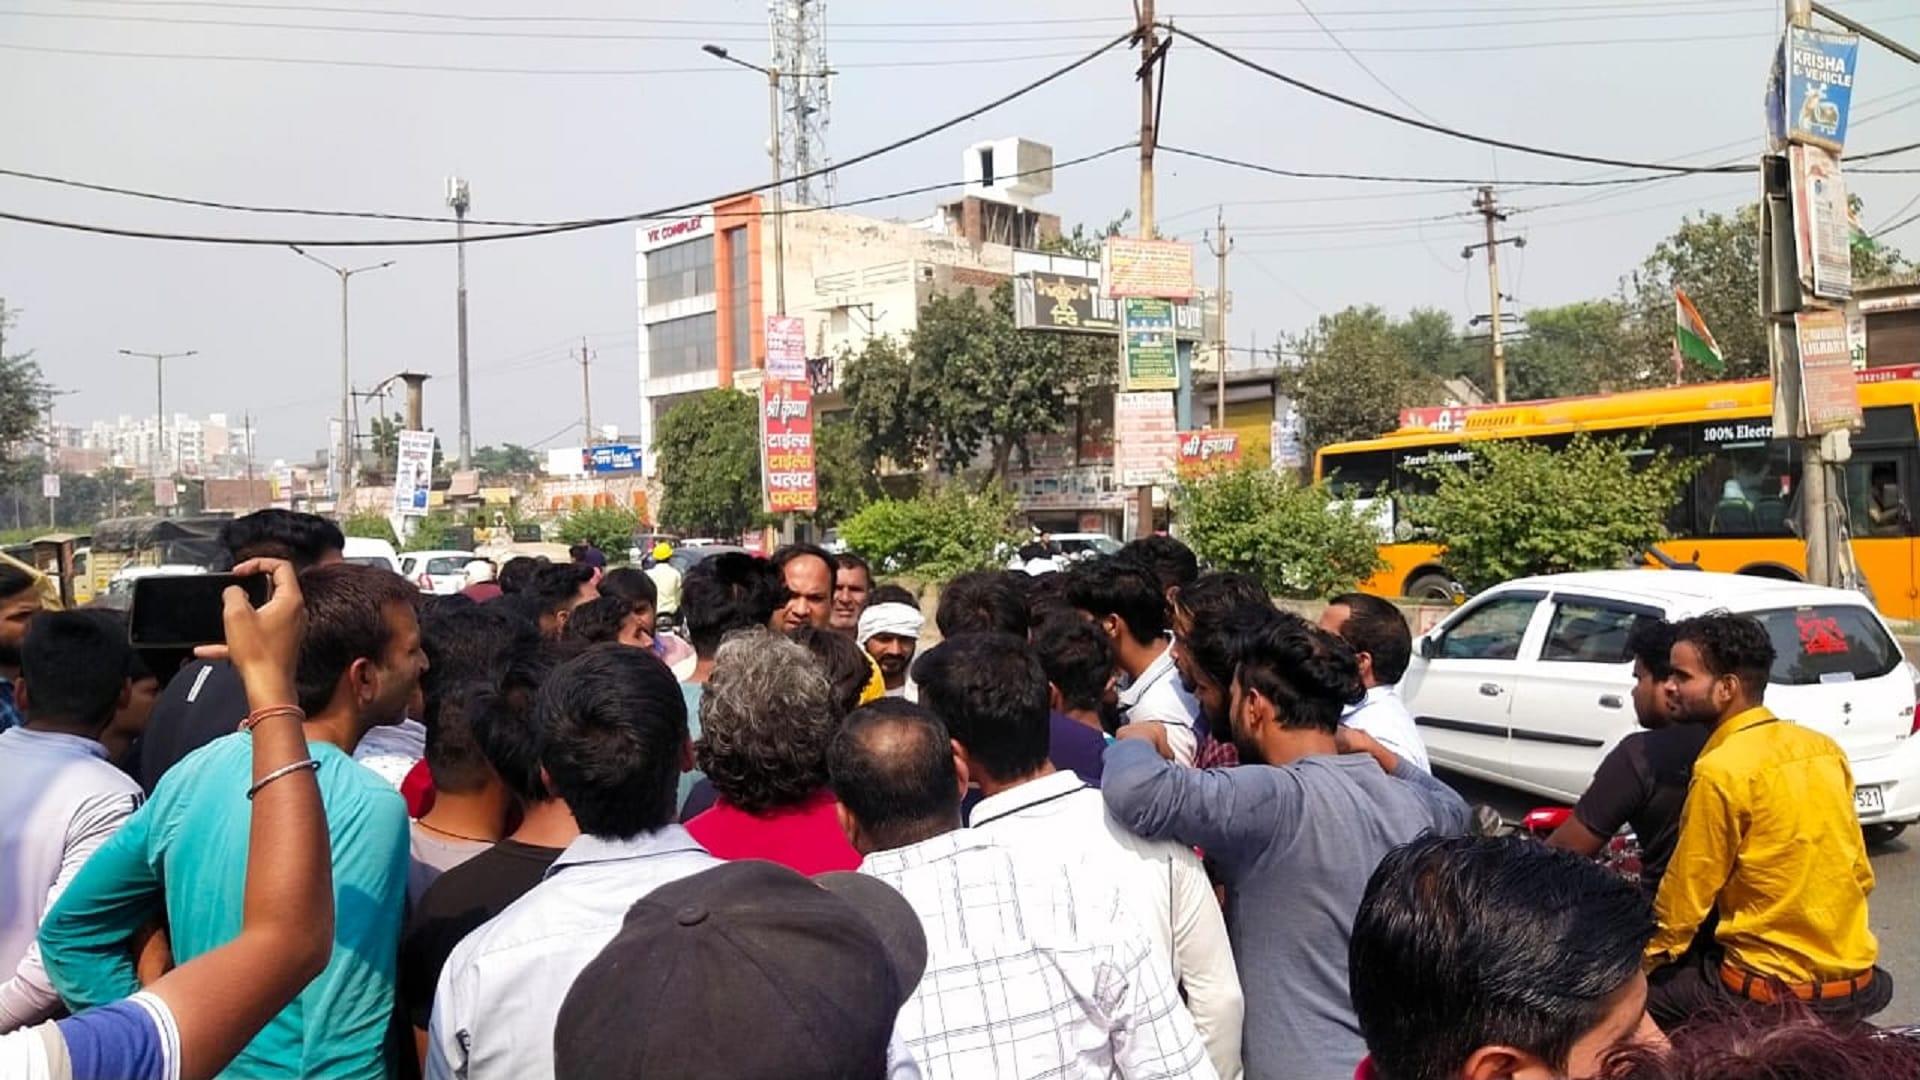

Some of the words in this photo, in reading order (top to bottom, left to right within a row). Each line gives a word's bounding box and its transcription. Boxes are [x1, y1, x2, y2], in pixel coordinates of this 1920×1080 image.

[1793, 50, 1845, 73] KRISHA
[661, 215, 702, 239] COMPLEX
[1803, 340, 1846, 356] LIBRARY
[1704, 426, 1734, 441] 100%
[1736, 424, 1773, 439] Electr
[1404, 455, 1428, 465] Zero
[1853, 791, 1880, 806] 521
